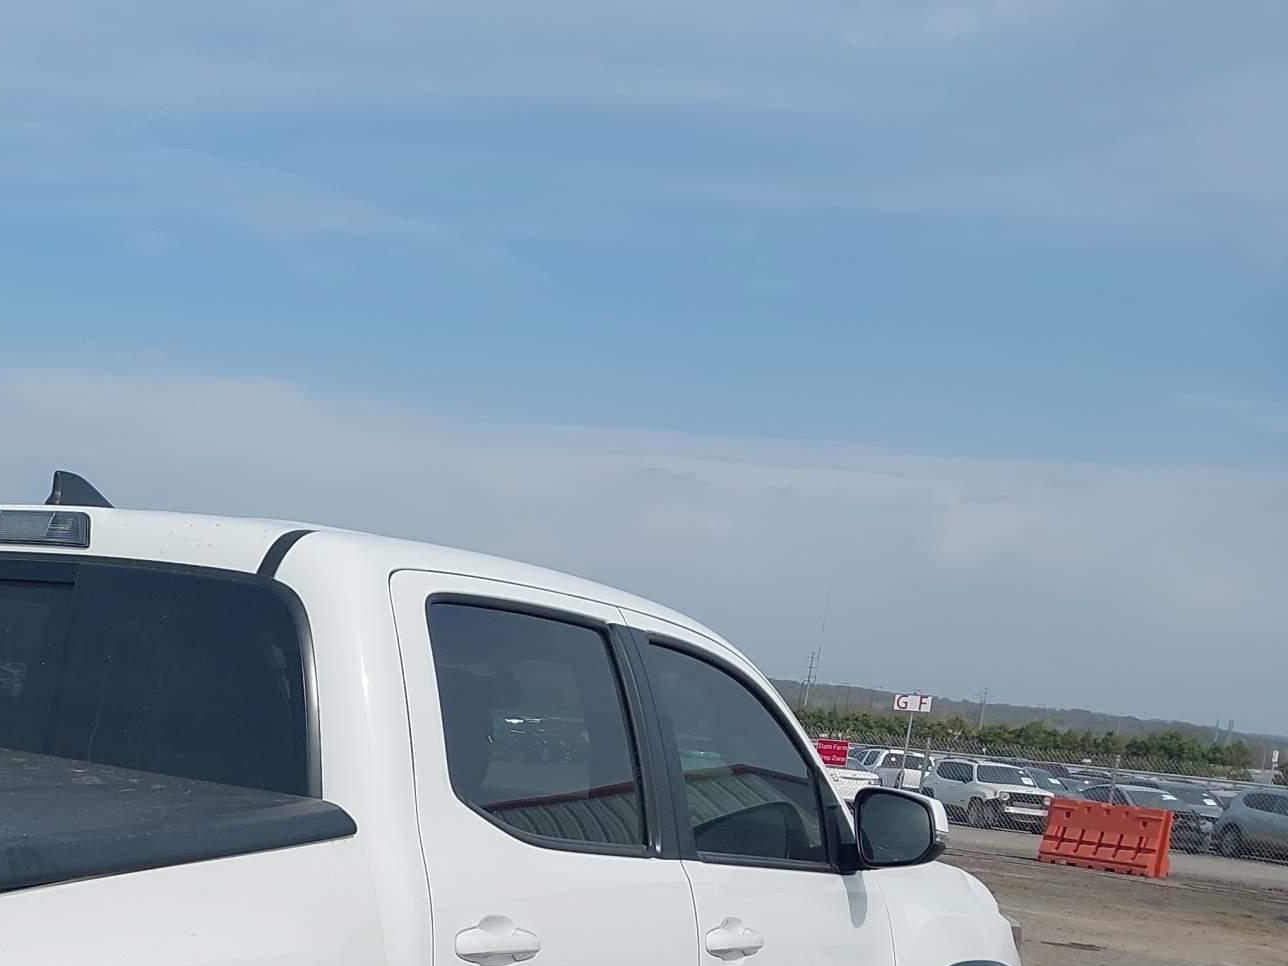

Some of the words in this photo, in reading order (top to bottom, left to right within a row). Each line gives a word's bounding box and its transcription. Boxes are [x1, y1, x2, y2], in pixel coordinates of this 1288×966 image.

[897, 695, 909, 710] G
[919, 695, 929, 711] F
[832, 754, 846, 762] Zone
